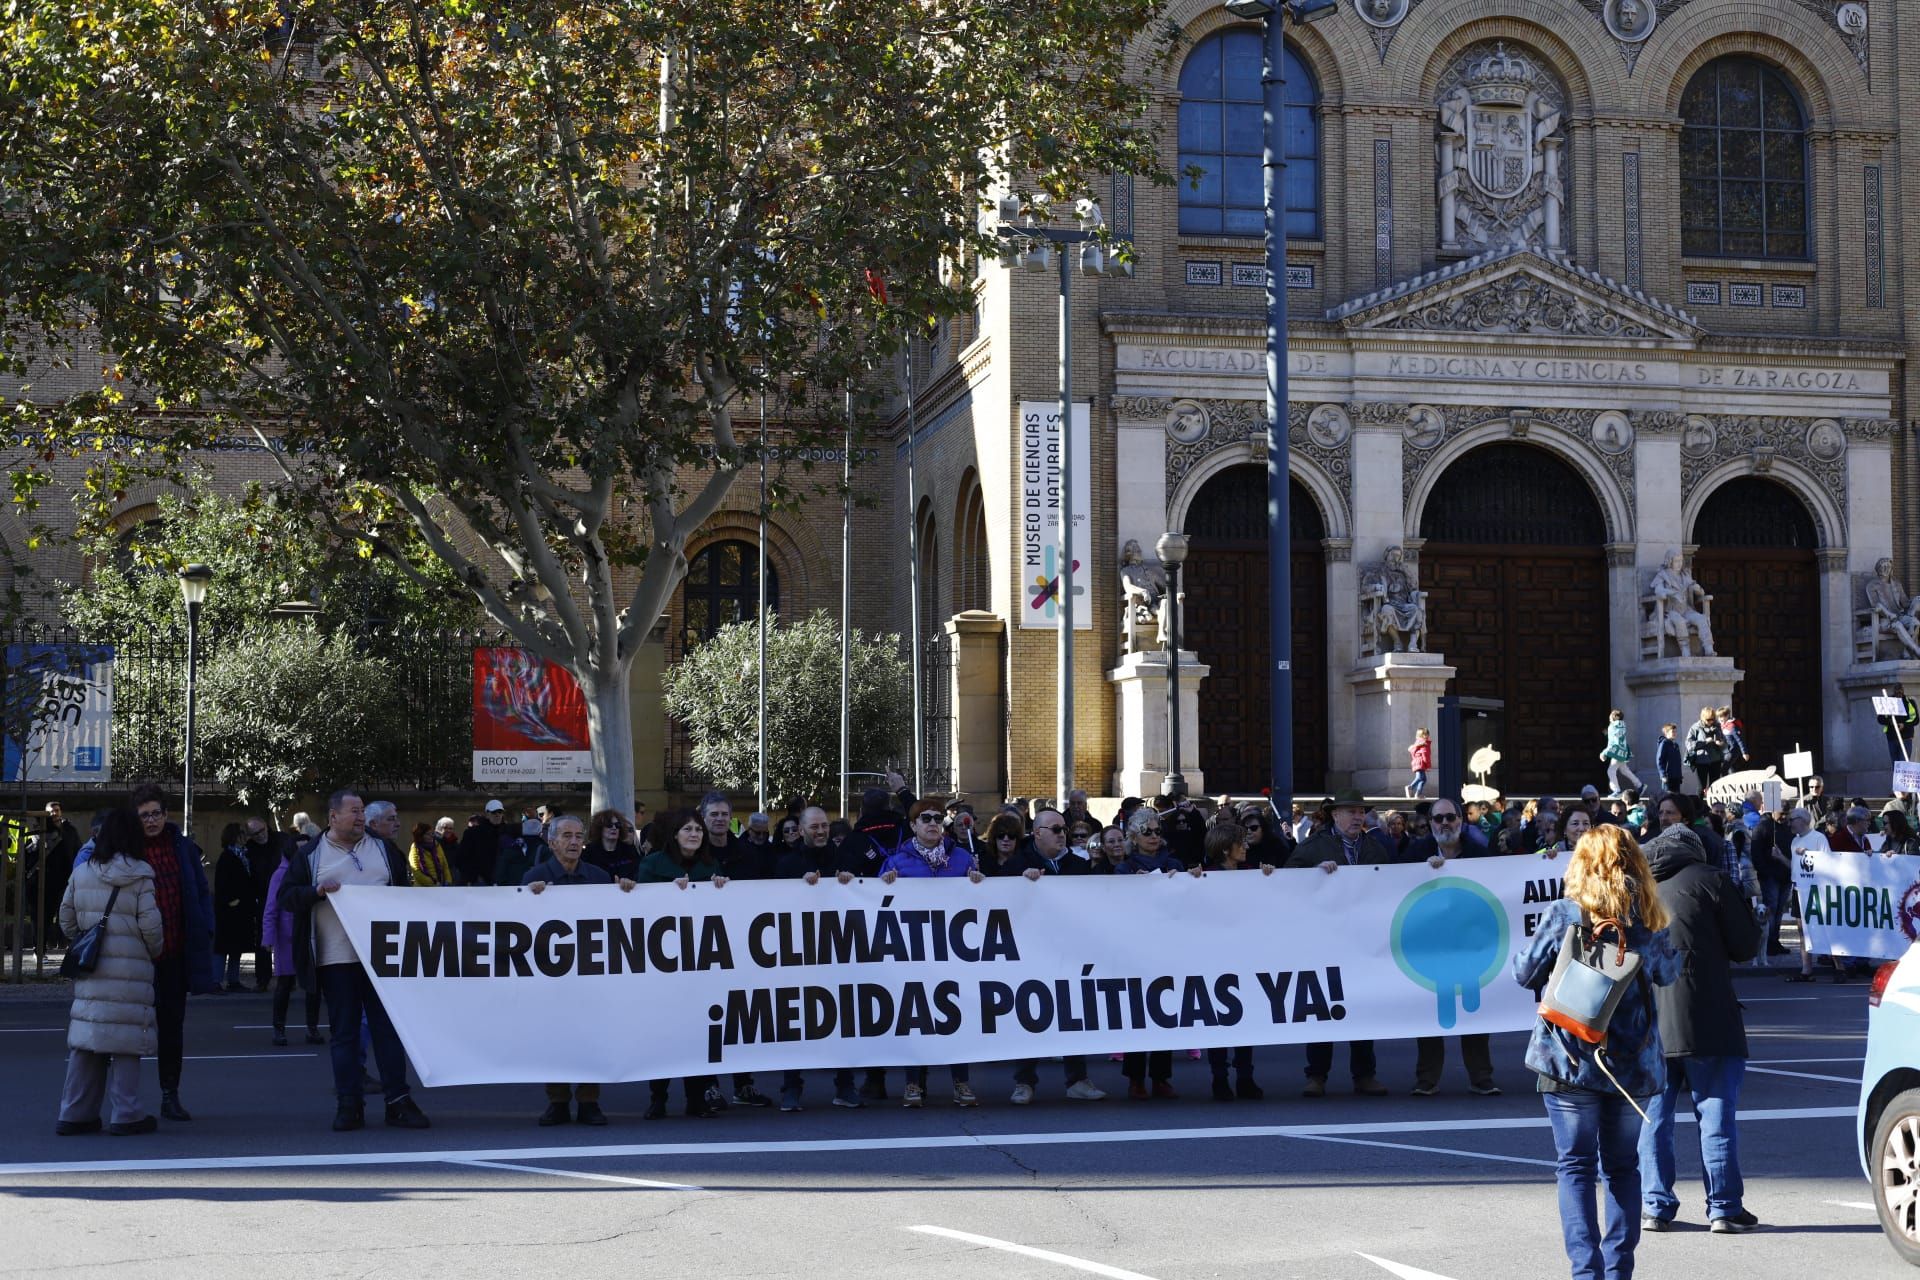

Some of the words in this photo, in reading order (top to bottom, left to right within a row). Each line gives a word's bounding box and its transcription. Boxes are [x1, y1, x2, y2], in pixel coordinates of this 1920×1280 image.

[1300, 354, 1327, 373] DE
[1388, 355, 1504, 377] MEDICINA
[1512, 360, 1527, 378] Y
[1535, 361, 1647, 382] CIENCIAS
[1697, 367, 1723, 385] DE
[1733, 368, 1861, 391] ZARAGOZA
[1025, 413, 1040, 483] CIENCIAS
[1026, 489, 1040, 508] DE
[1026, 513, 1041, 566] MUSEO
[481, 756, 518, 766] BROTO
[1805, 884, 1894, 930] AHORA
[371, 915, 735, 978] EMERGENCIA
[748, 895, 1021, 969] CLIMÁTICA
[708, 979, 962, 1064] ¡MEDIDAS
[979, 963, 1244, 1034] POLÍTICAS
[1255, 966, 1347, 1024] YA!
